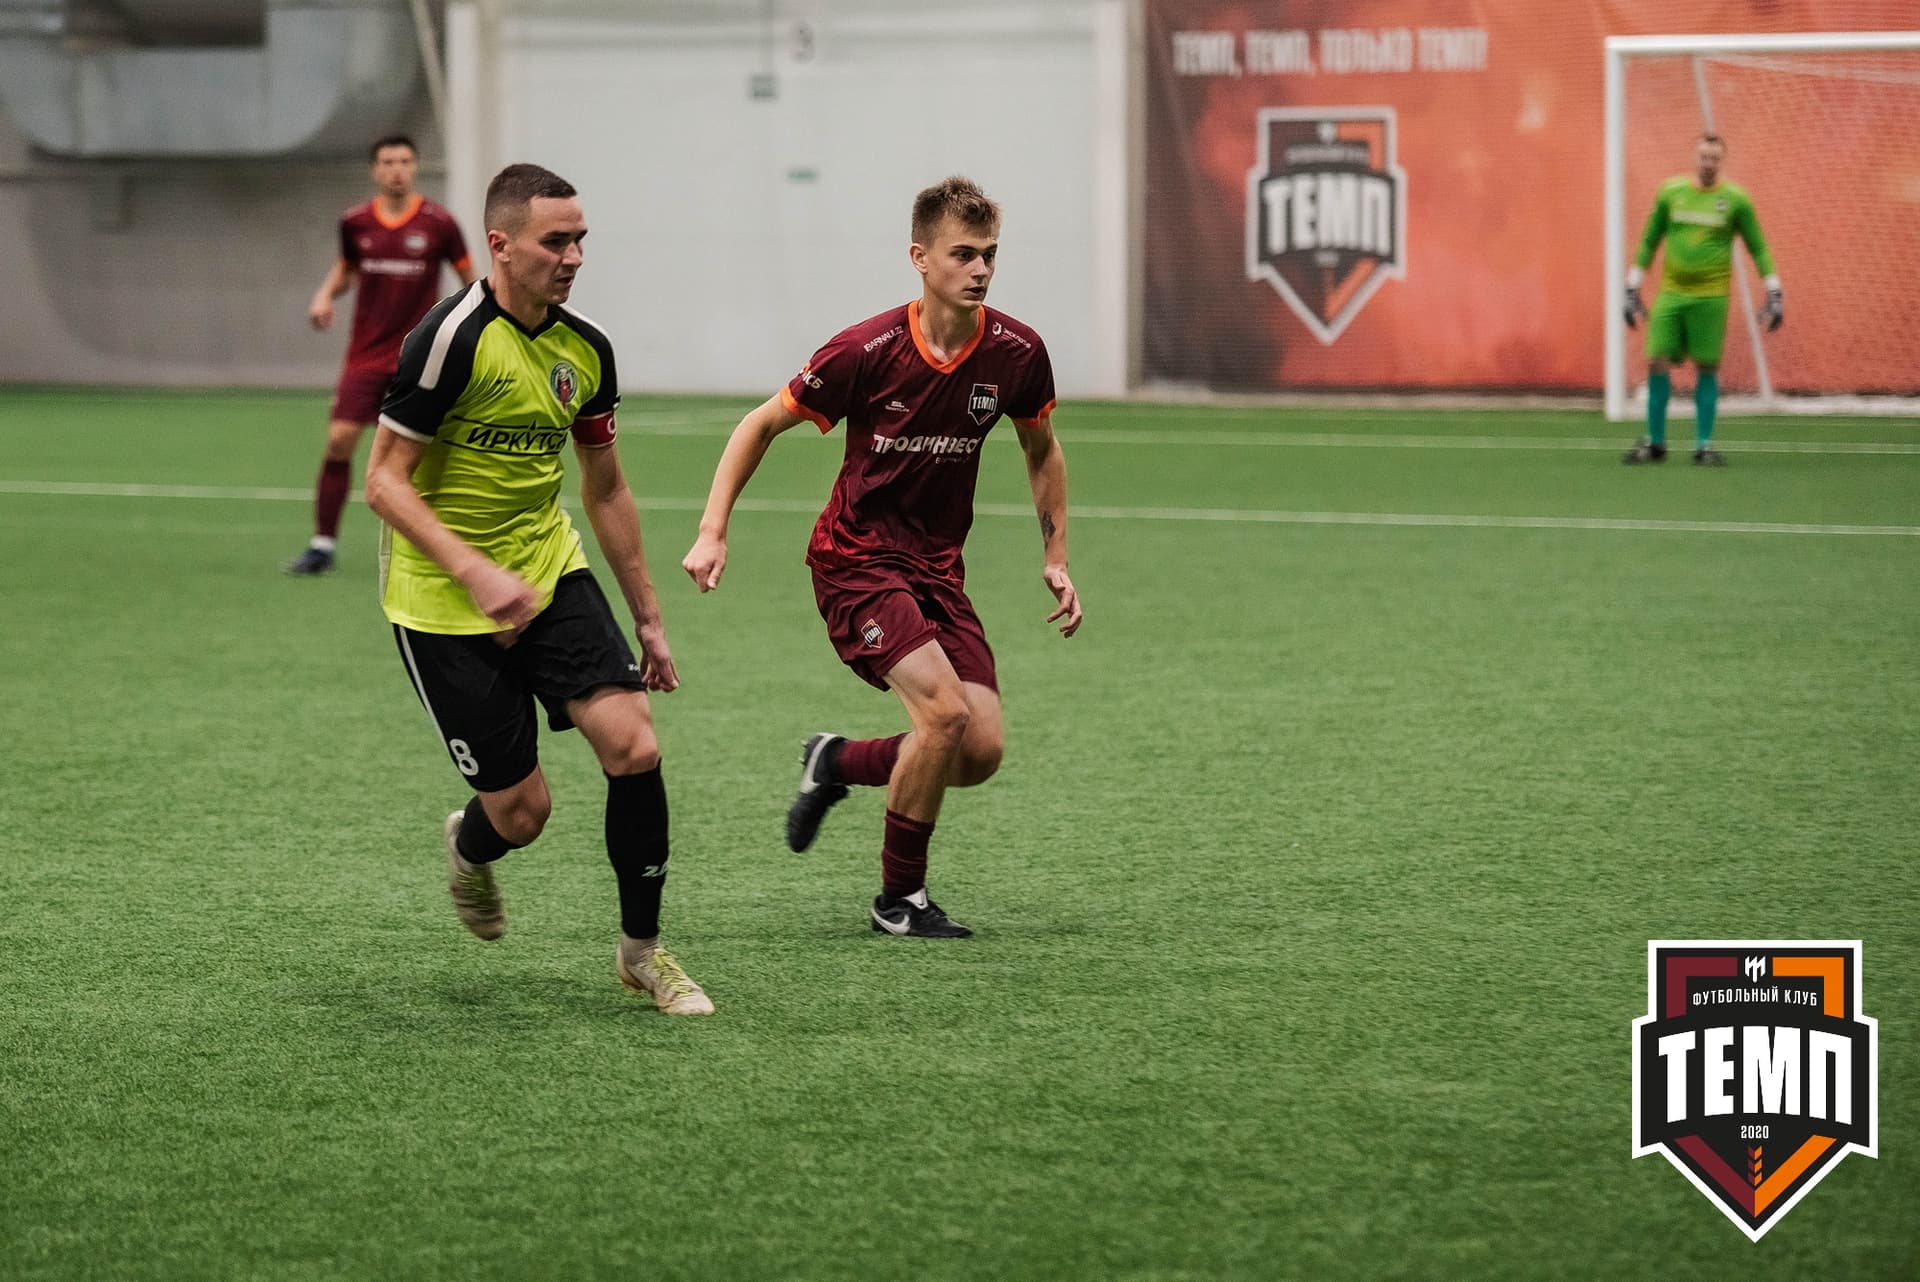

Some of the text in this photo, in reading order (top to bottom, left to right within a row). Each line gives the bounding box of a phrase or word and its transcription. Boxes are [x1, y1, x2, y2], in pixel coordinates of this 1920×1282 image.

[1264, 172, 1391, 257] ТЕМП
[972, 396, 995, 411] ТЕМП
[871, 433, 982, 455] ПРОДИНВЕС
[450, 738, 479, 776] 8
